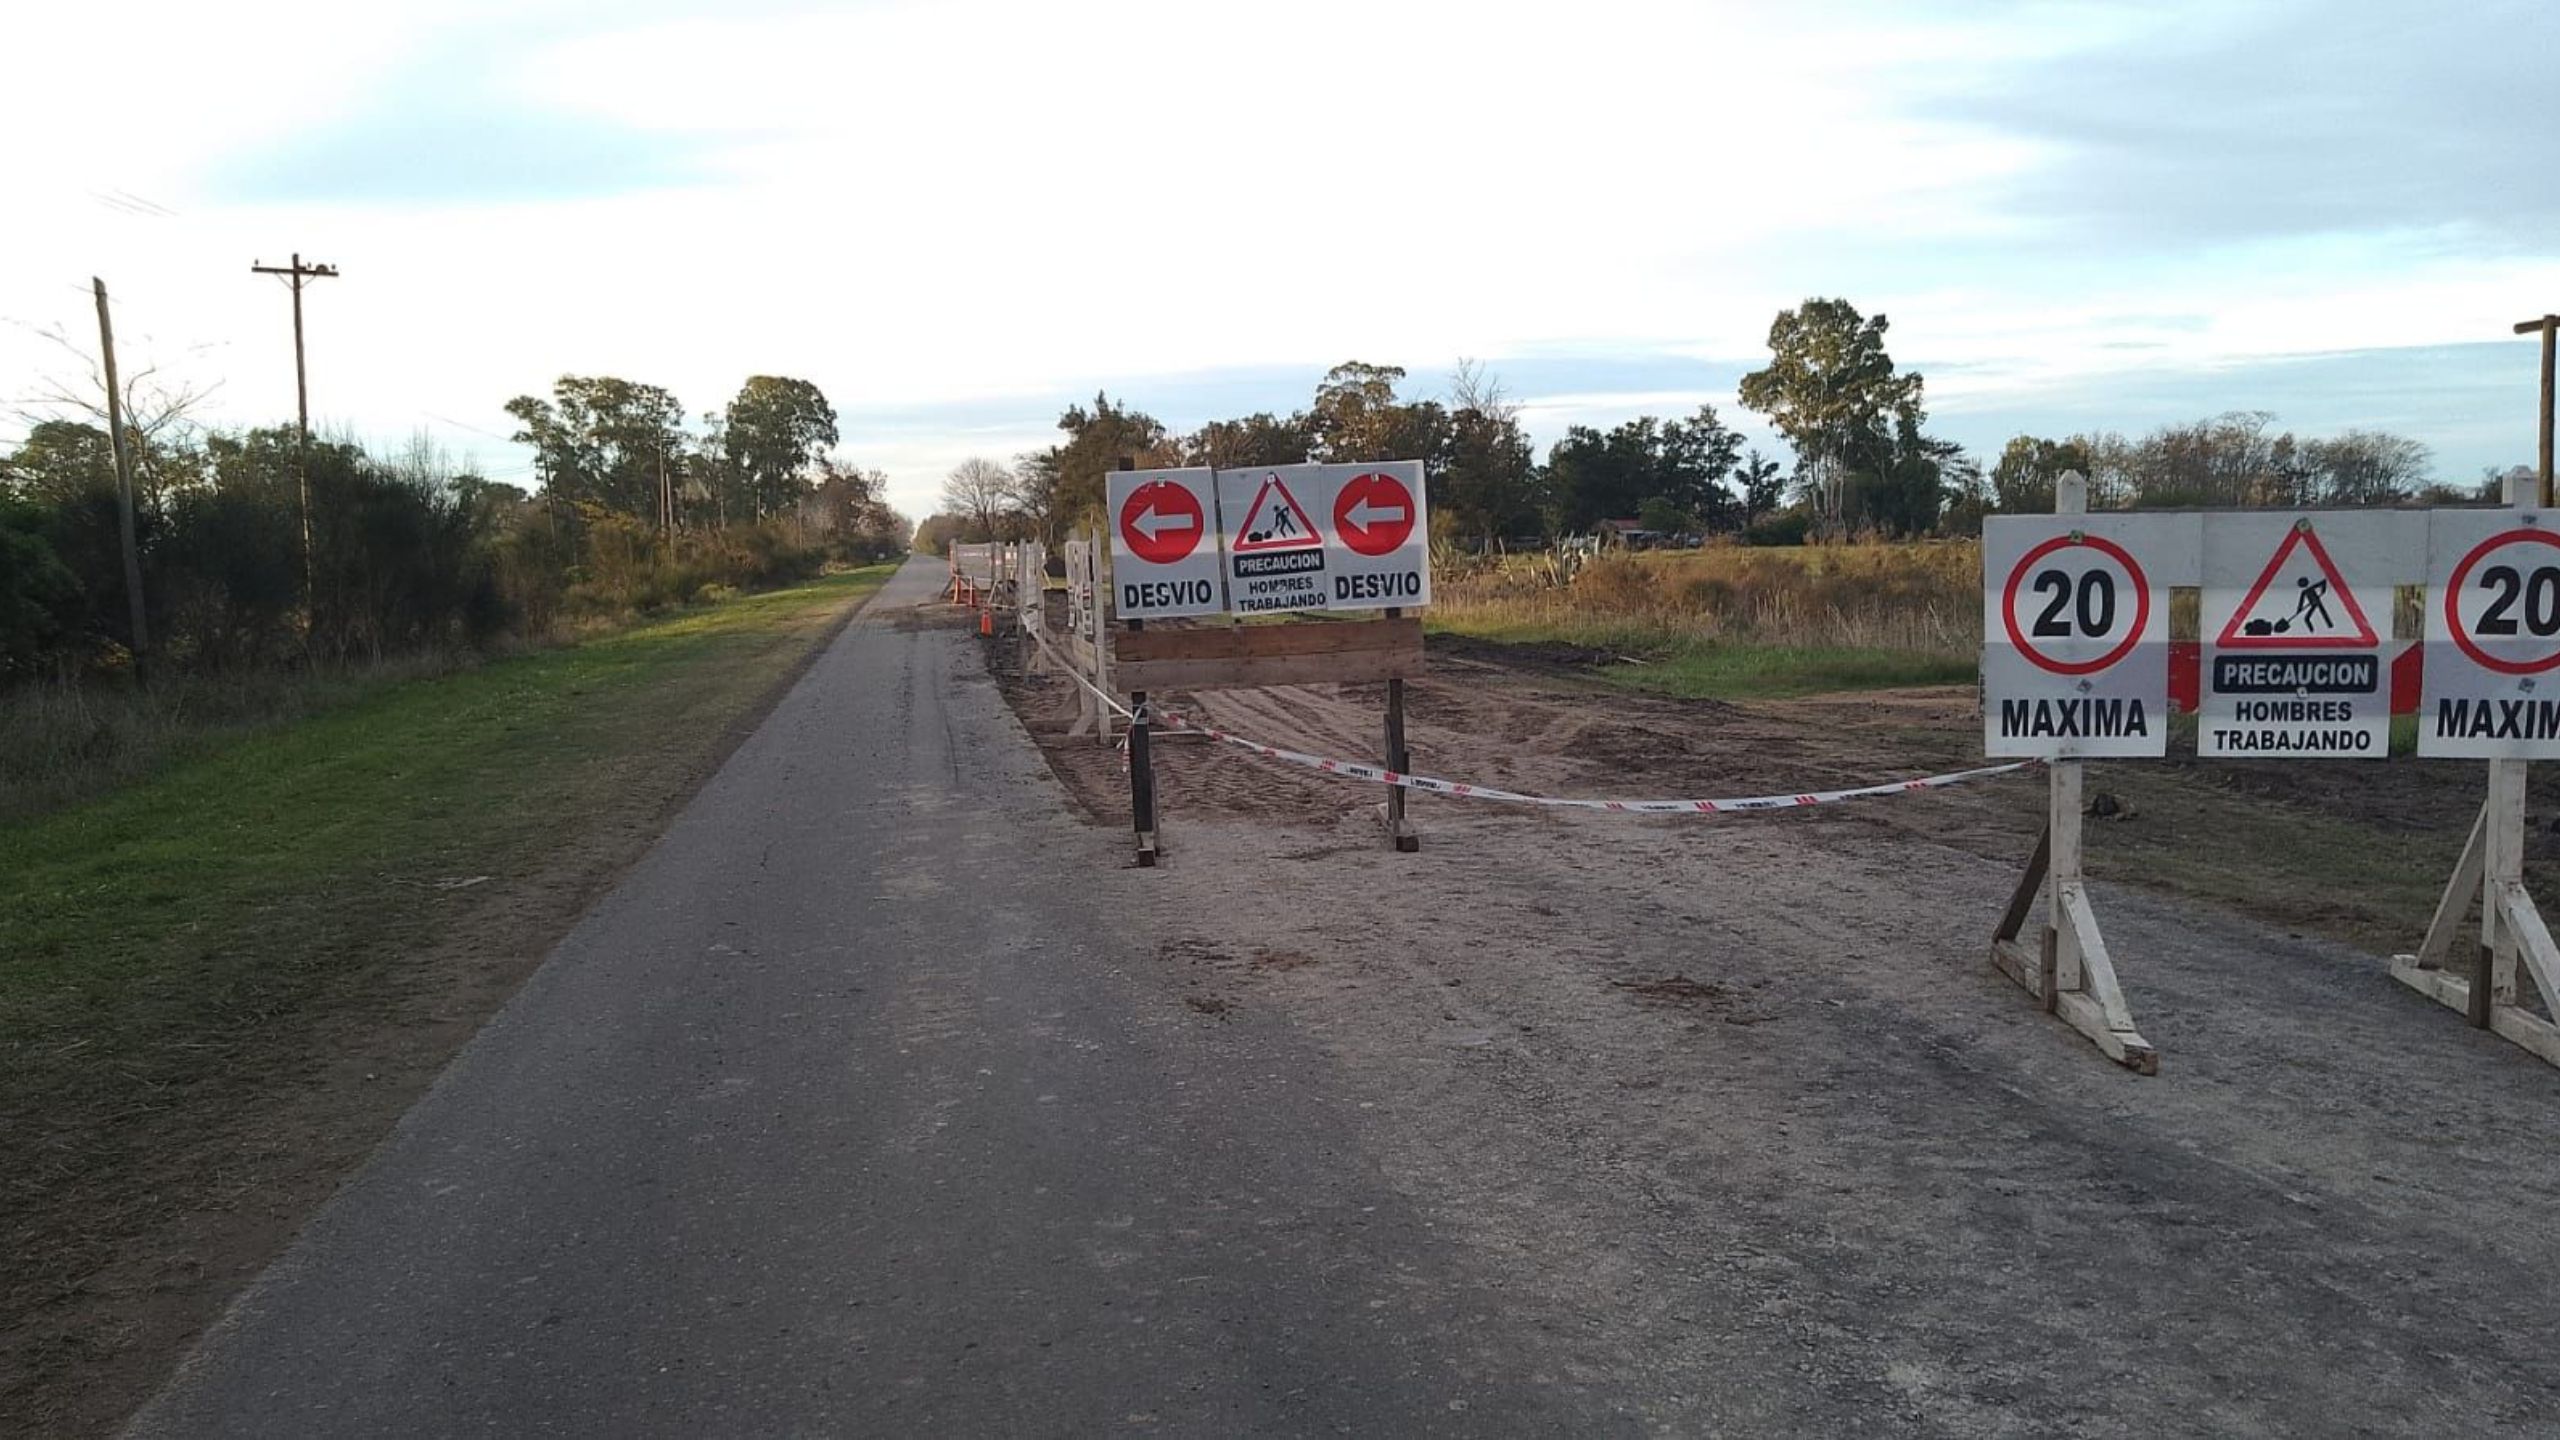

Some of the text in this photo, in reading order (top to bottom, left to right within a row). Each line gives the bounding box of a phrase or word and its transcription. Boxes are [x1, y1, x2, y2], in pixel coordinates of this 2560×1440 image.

[1239, 555, 1320, 573] PRECAUCION
[1124, 579, 1212, 608] DESVIO
[1335, 571, 1421, 600] DESVIO
[1239, 593, 1327, 612] TRABAJANDO
[2032, 569, 2116, 638] 20
[2475, 565, 2560, 636] 20
[2223, 662, 2370, 686] PRECAUCION
[2001, 699, 2148, 738] MAXIMA
[2235, 701, 2353, 722] HOMBRES
[2214, 730, 2371, 751] TRABAJANDO
